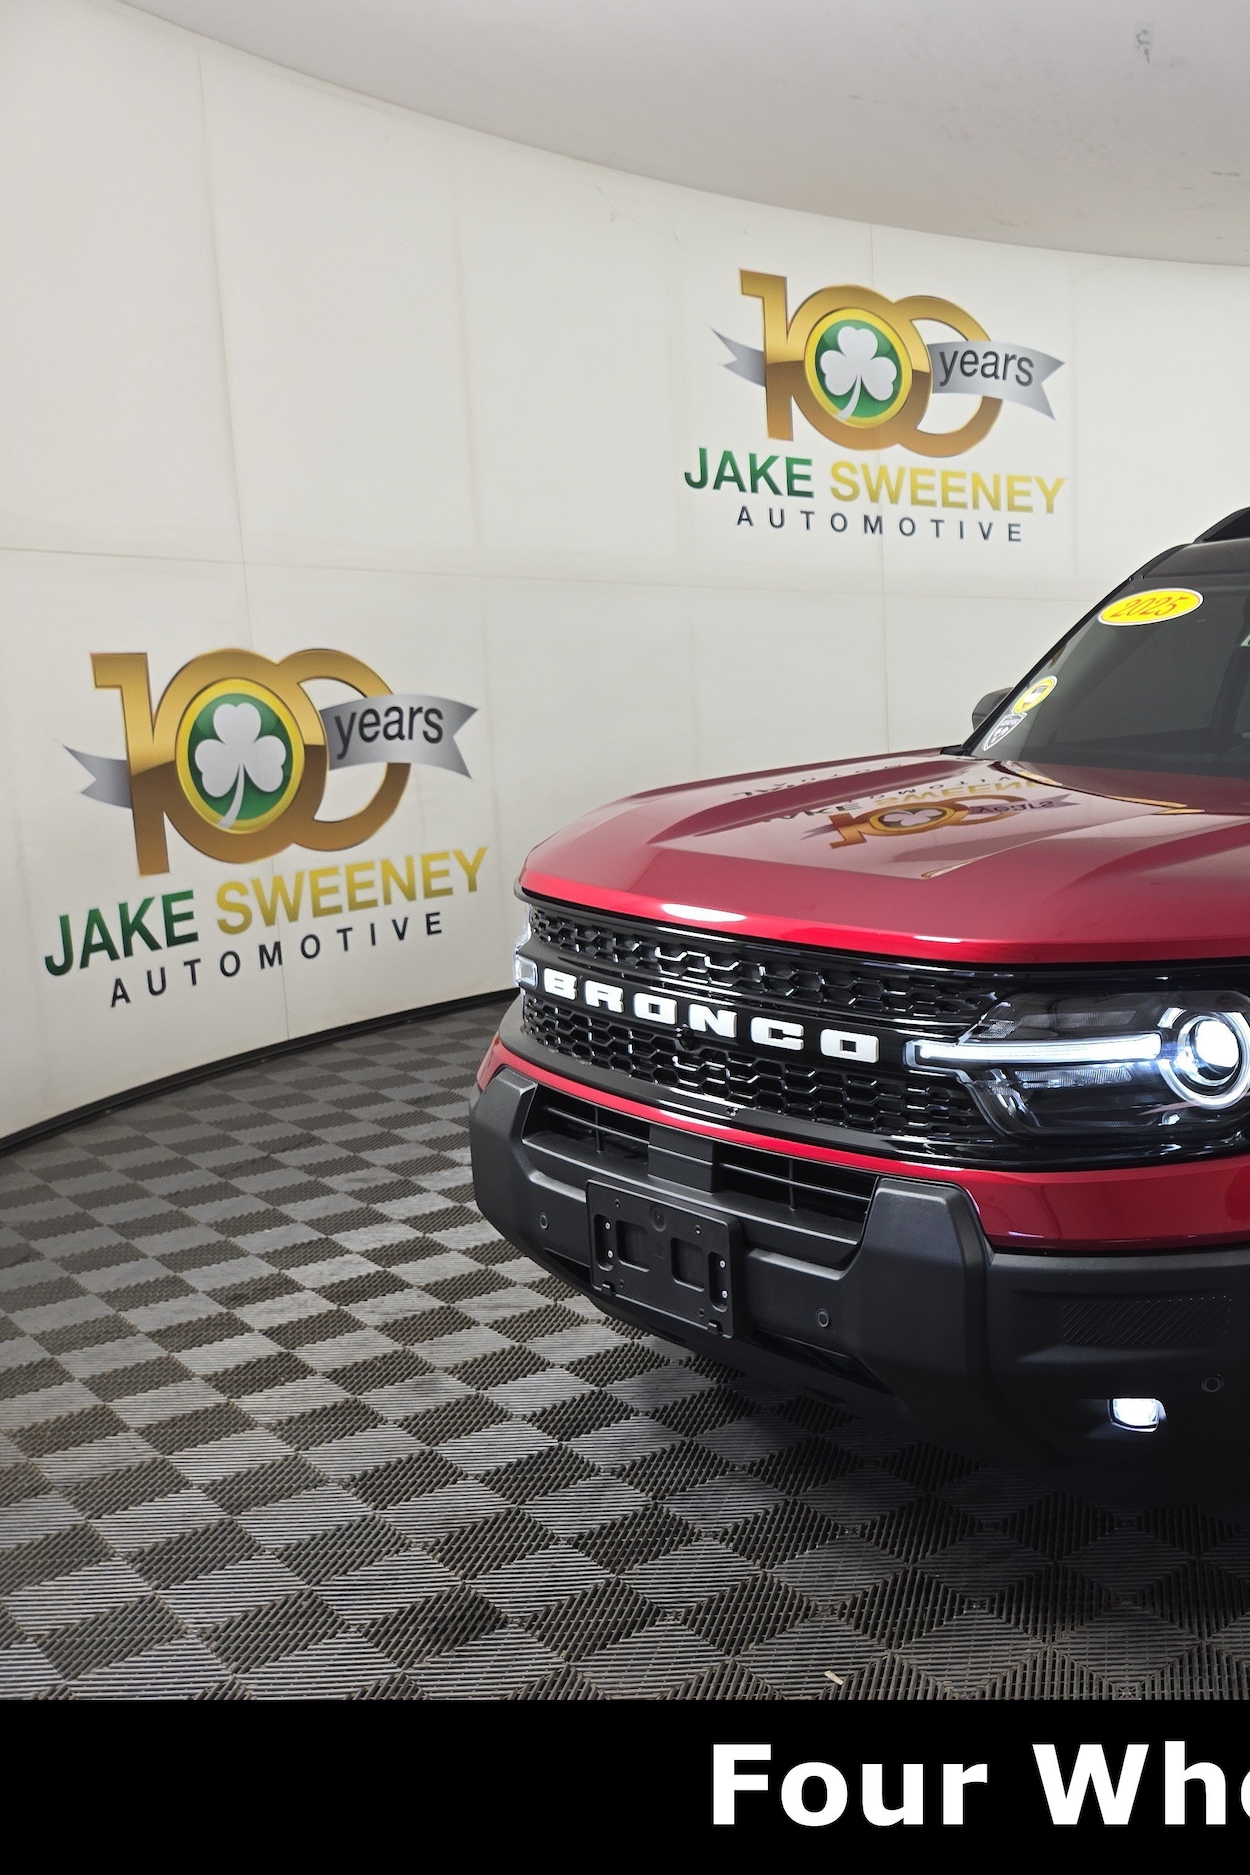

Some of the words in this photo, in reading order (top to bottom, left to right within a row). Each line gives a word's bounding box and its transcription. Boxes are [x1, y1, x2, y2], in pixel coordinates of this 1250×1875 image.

[739, 269, 1003, 458] 100
[939, 349, 1035, 387] years
[684, 447, 814, 498] JAKE
[830, 461, 1065, 514] SWEENEY
[737, 506, 1022, 542] AUTOMOTIVE
[1109, 596, 1191, 618] 2025
[90, 648, 411, 877] 100
[334, 705, 444, 760] years
[44, 889, 199, 977] JAKE
[216, 846, 488, 936] SWEENEY
[110, 912, 442, 1008] AUTOMOTIVE
[543, 967, 879, 1063] BRONCO
